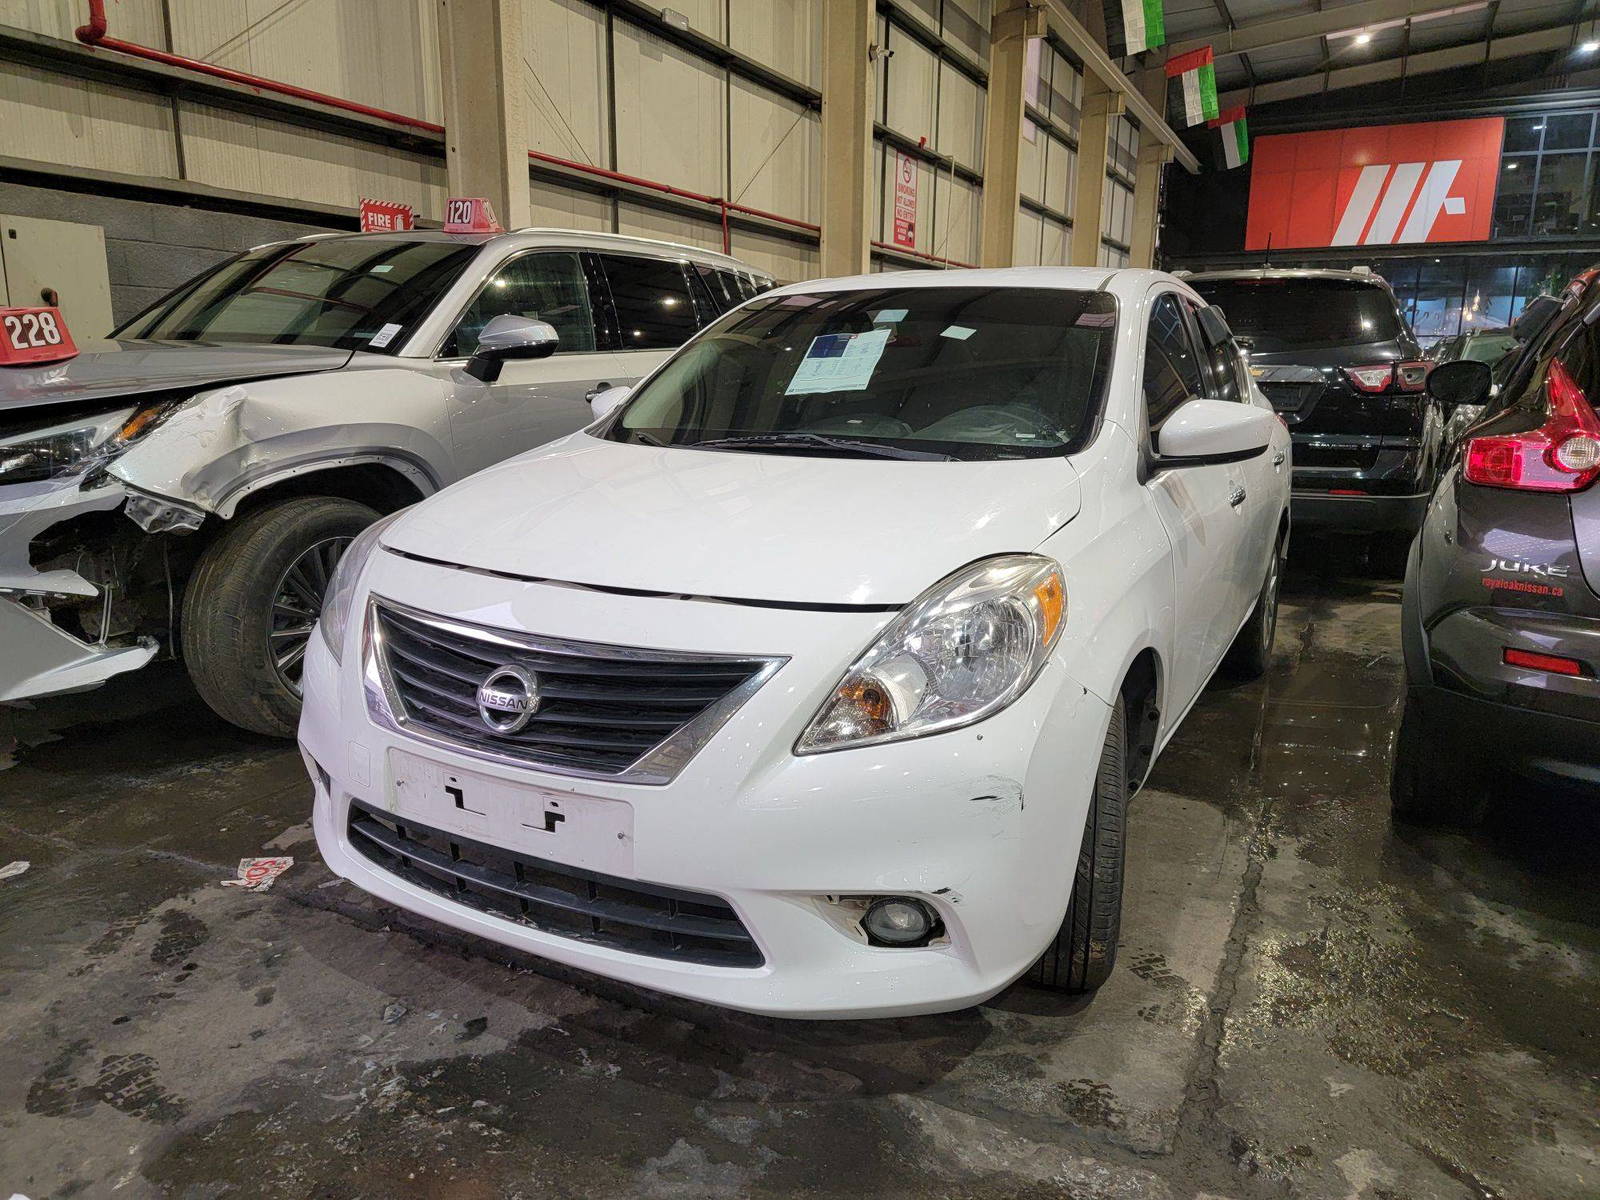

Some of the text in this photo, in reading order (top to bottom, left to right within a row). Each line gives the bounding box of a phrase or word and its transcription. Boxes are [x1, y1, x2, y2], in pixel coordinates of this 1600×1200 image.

[368, 212, 391, 228] FIRE
[449, 201, 472, 224] 120
[5, 312, 61, 349] 228
[1480, 558, 1570, 578] JUKE
[1482, 577, 1563, 596] royaloaknissan.ca
[479, 690, 529, 710] NISSAN
